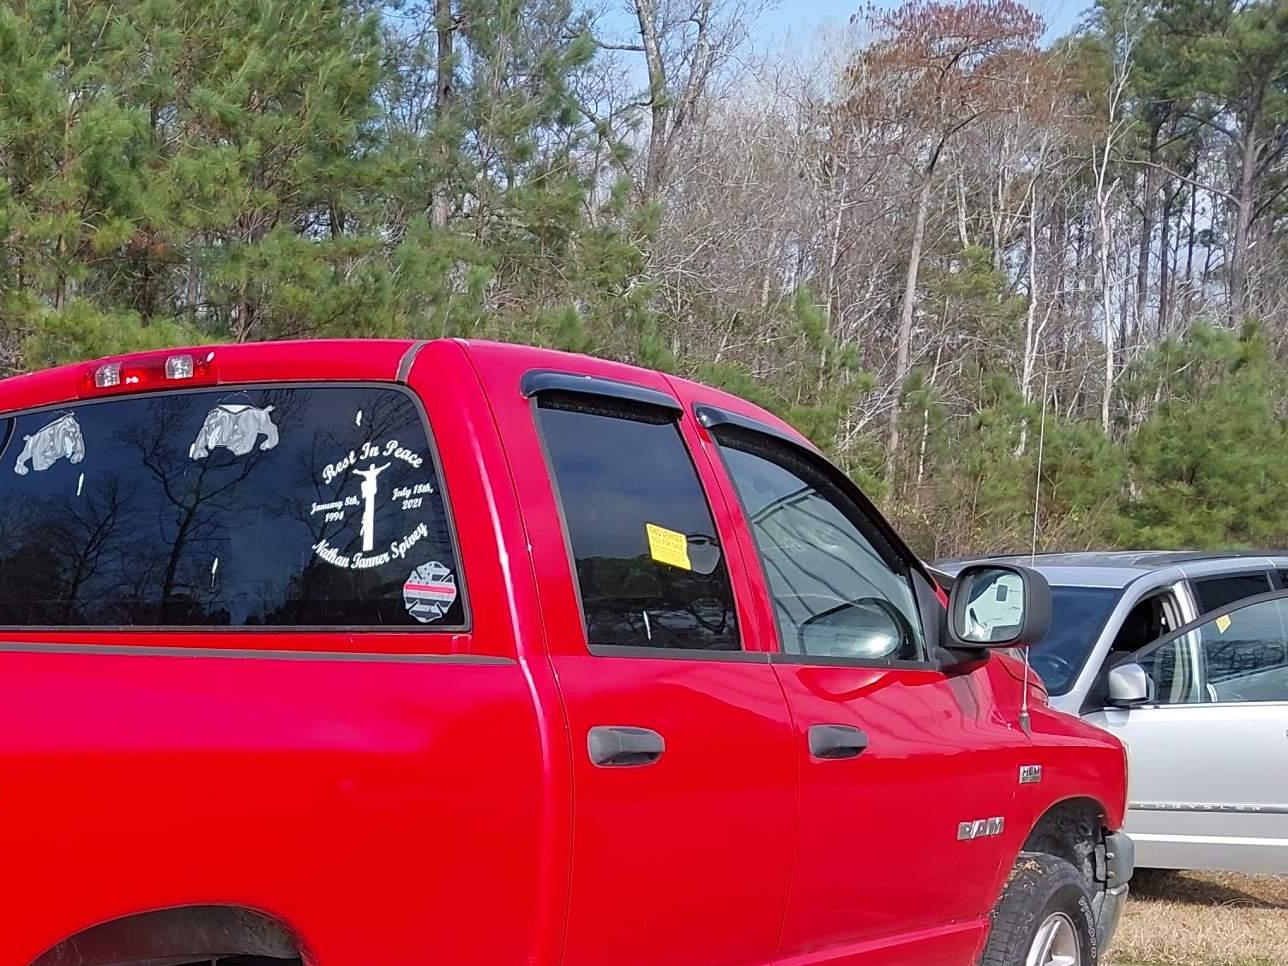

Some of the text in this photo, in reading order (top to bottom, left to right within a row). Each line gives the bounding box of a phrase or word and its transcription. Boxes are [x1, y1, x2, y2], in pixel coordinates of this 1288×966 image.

[322, 439, 423, 485] Rest In Peace
[392, 486, 412, 501] July
[310, 500, 344, 516] January
[401, 497, 423, 510] 2021
[311, 521, 429, 569] Nathan Tanner Spivey
[1138, 799, 1262, 813] CHRYSLER
[956, 816, 1005, 841] RAM
